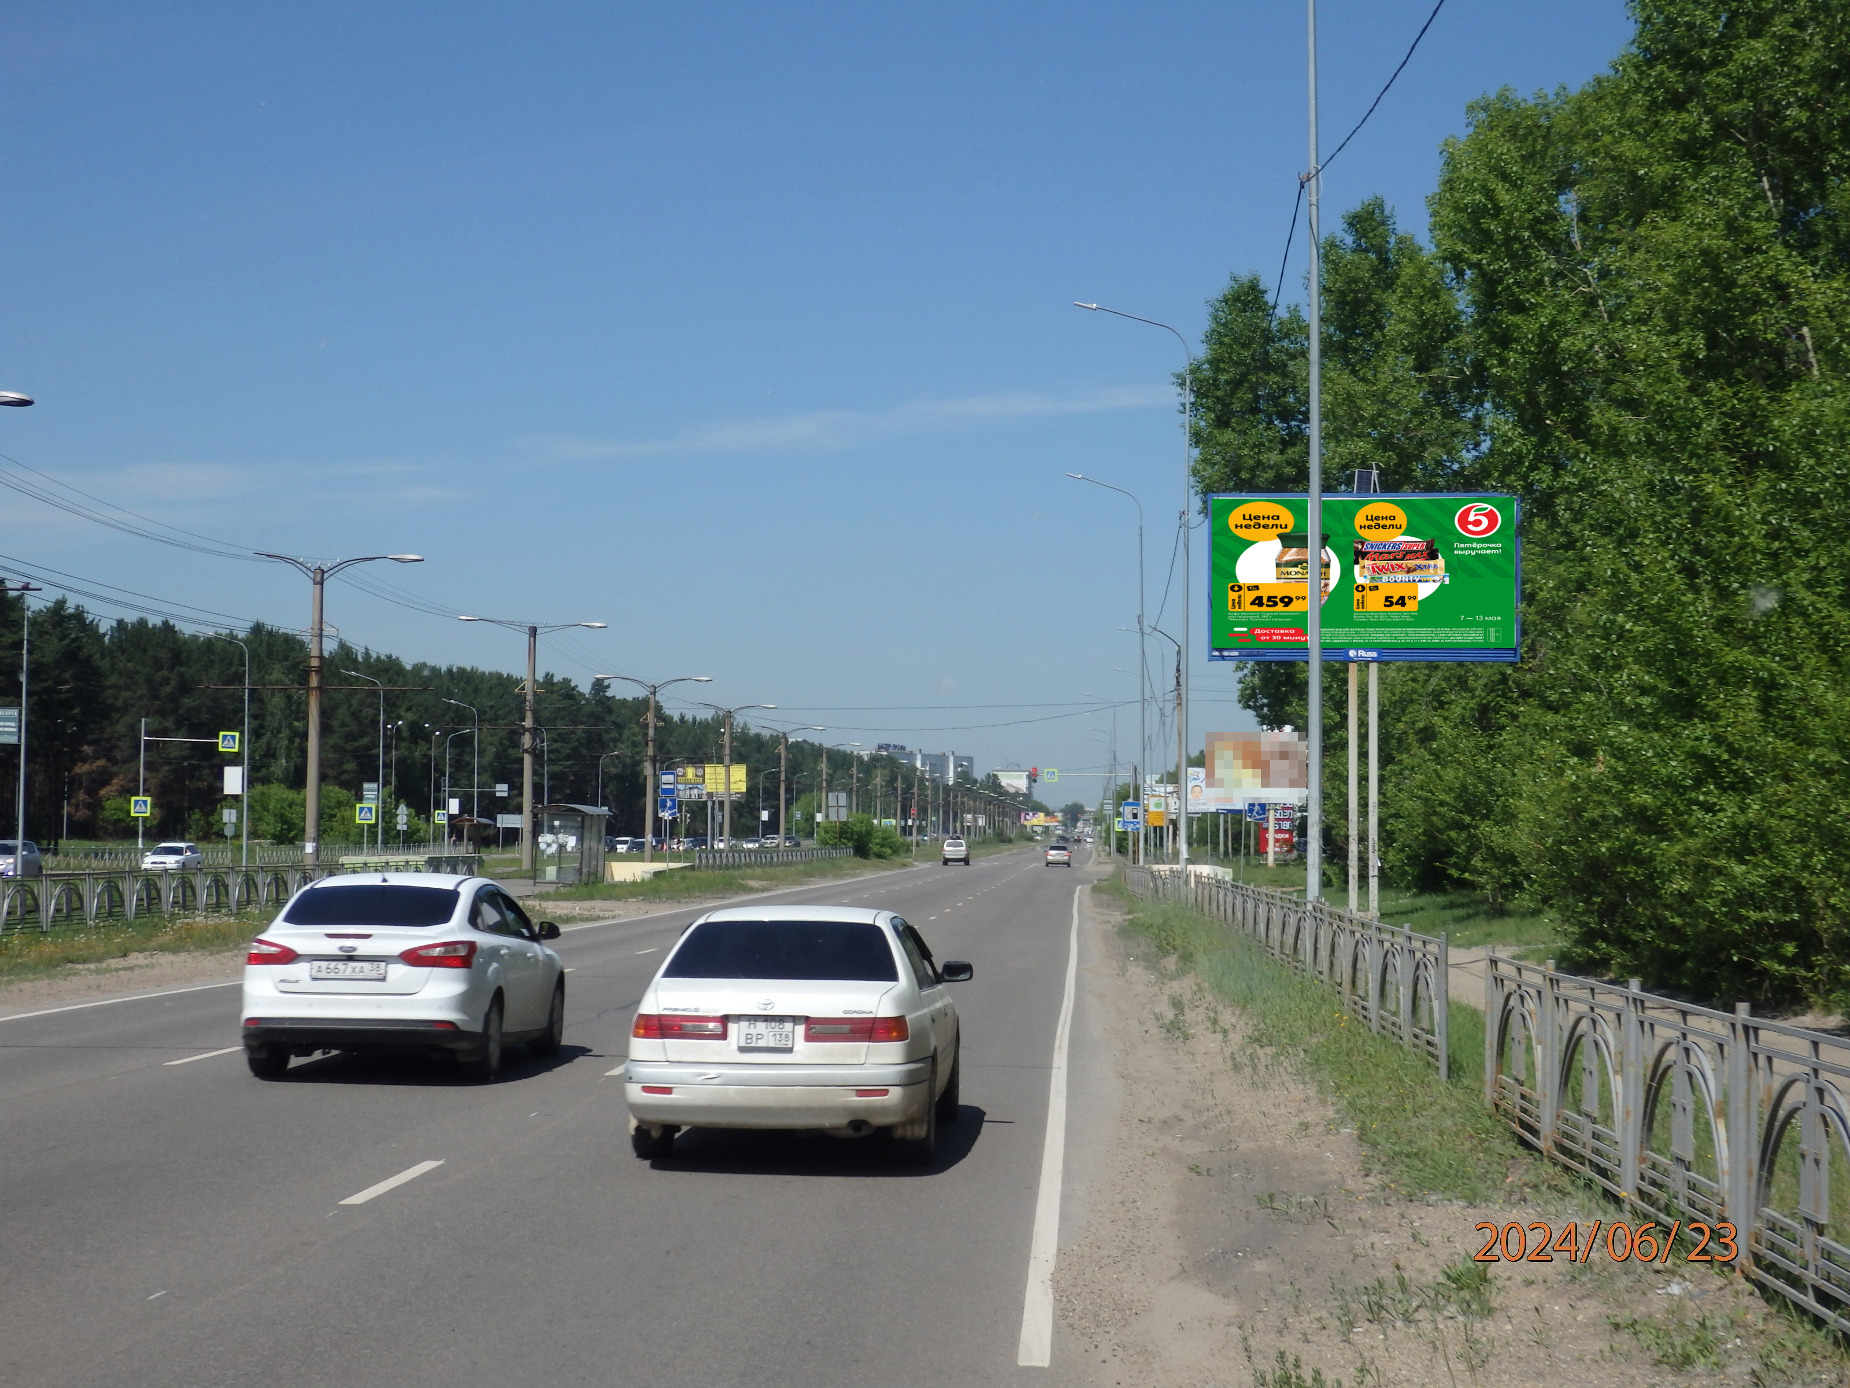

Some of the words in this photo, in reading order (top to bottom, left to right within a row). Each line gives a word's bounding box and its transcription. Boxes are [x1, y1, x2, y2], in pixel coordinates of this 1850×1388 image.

[1242, 513, 1280, 522] Цена
[1365, 514, 1396, 523] Цена
[1466, 505, 1491, 532] 5
[1234, 522, 1288, 530] недели
[1363, 542, 1403, 551] SNICKERS
[1402, 542, 1426, 550] SUPER
[1382, 575, 1421, 583] BOUNTY
[1249, 595, 1294, 608] 459
[1383, 595, 1407, 608] 54
[1357, 649, 1378, 658] Russ
[747, 1017, 757, 1029] Н
[762, 1017, 785, 1030] 108
[744, 1033, 764, 1045] ВР
[771, 1033, 790, 1042] 138
